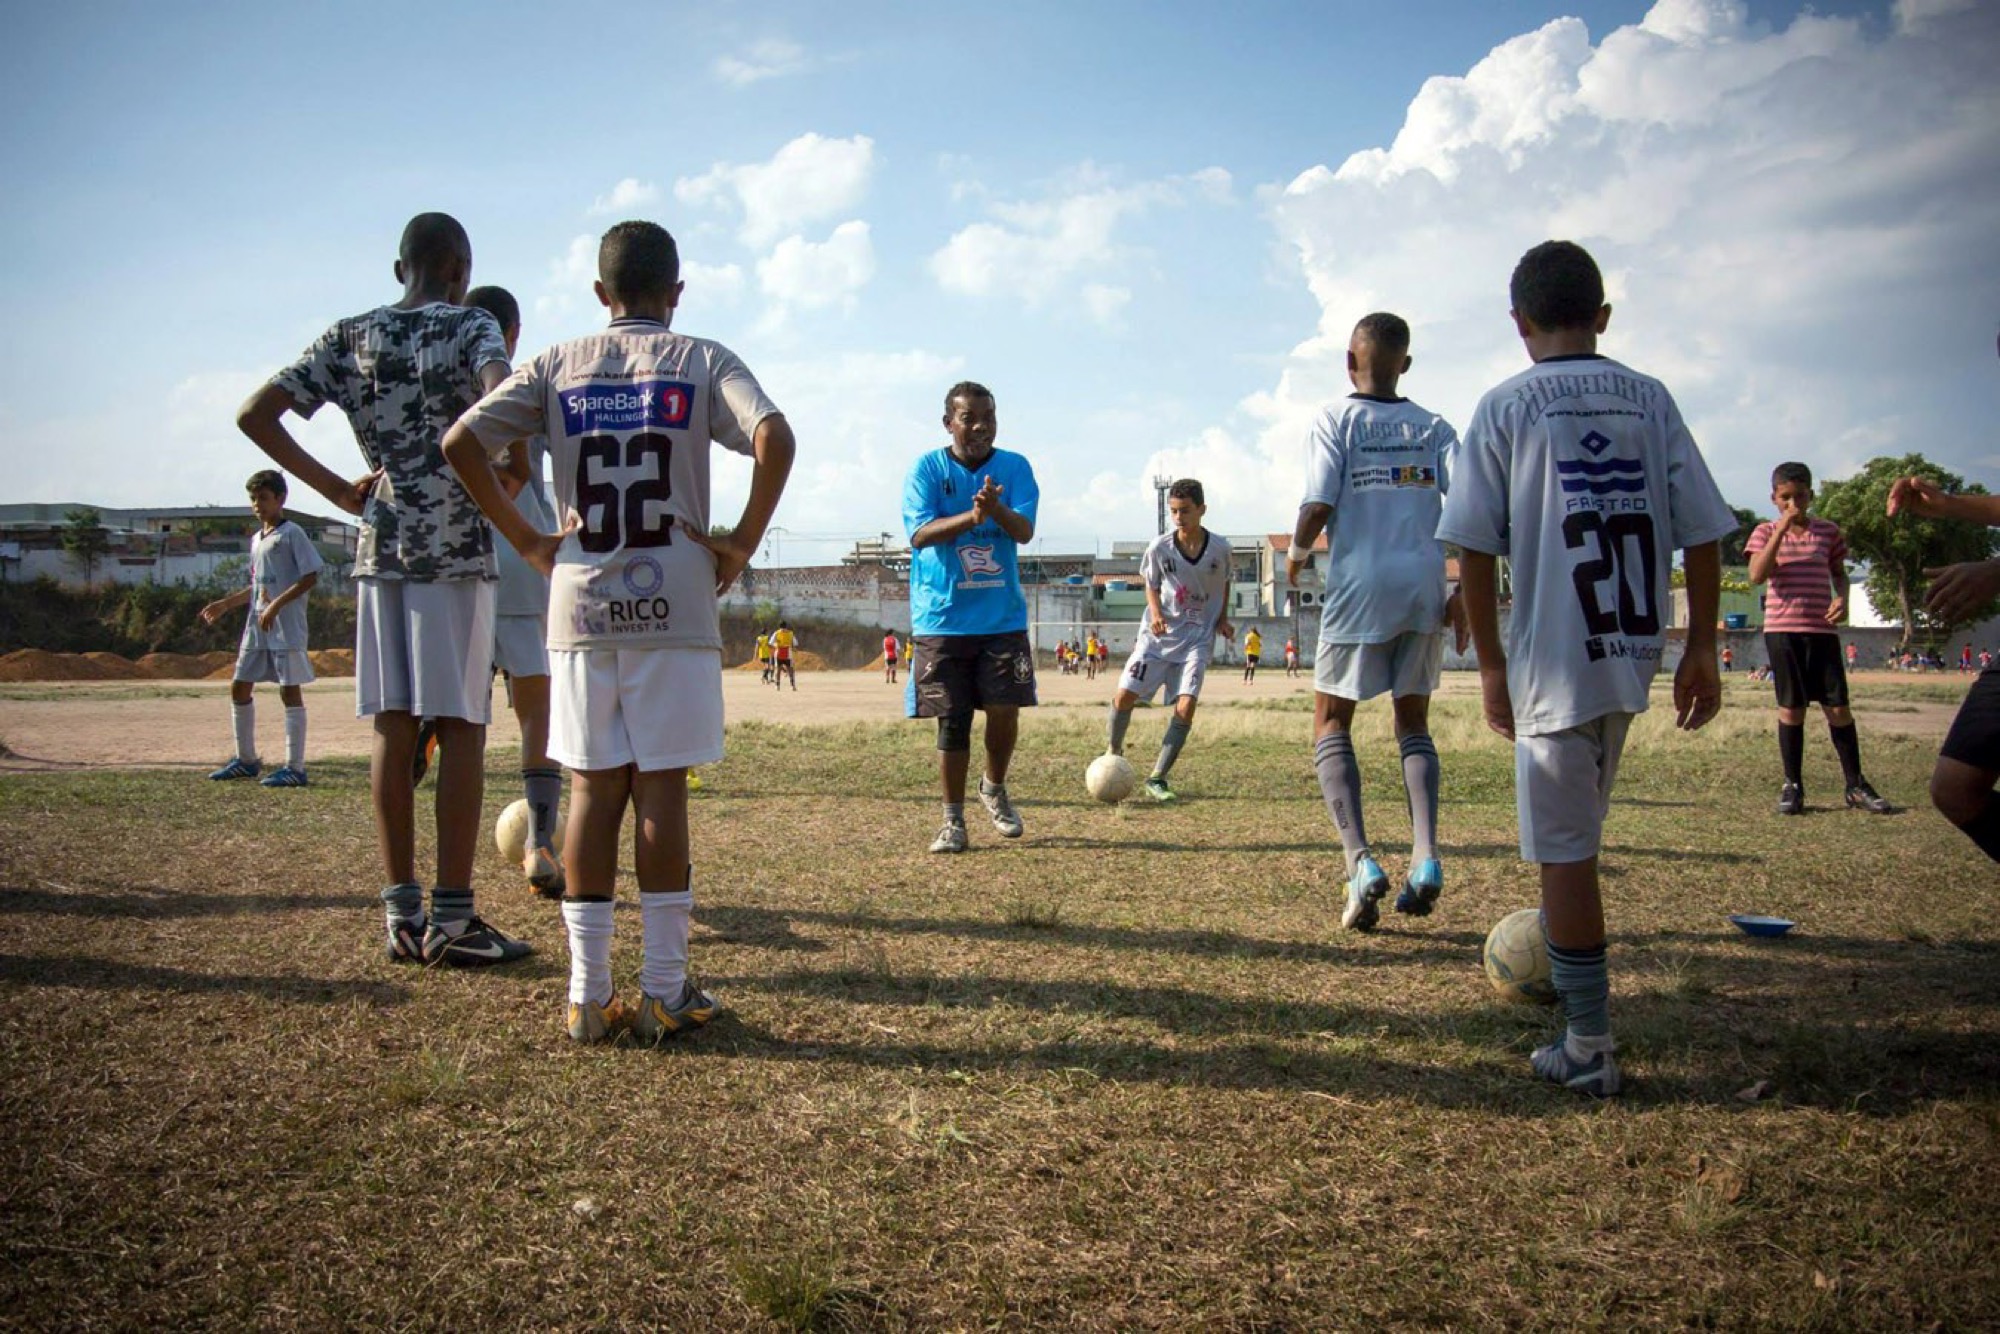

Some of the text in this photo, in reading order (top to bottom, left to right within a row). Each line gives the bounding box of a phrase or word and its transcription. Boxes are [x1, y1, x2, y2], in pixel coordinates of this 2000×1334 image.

[568, 388, 680, 416] SpareBank 1
[576, 432, 675, 553] 62
[1561, 510, 1660, 636] 20
[609, 597, 669, 622] RICO
[611, 622, 670, 634] INVEST AS
[1129, 661, 1147, 681] 41
